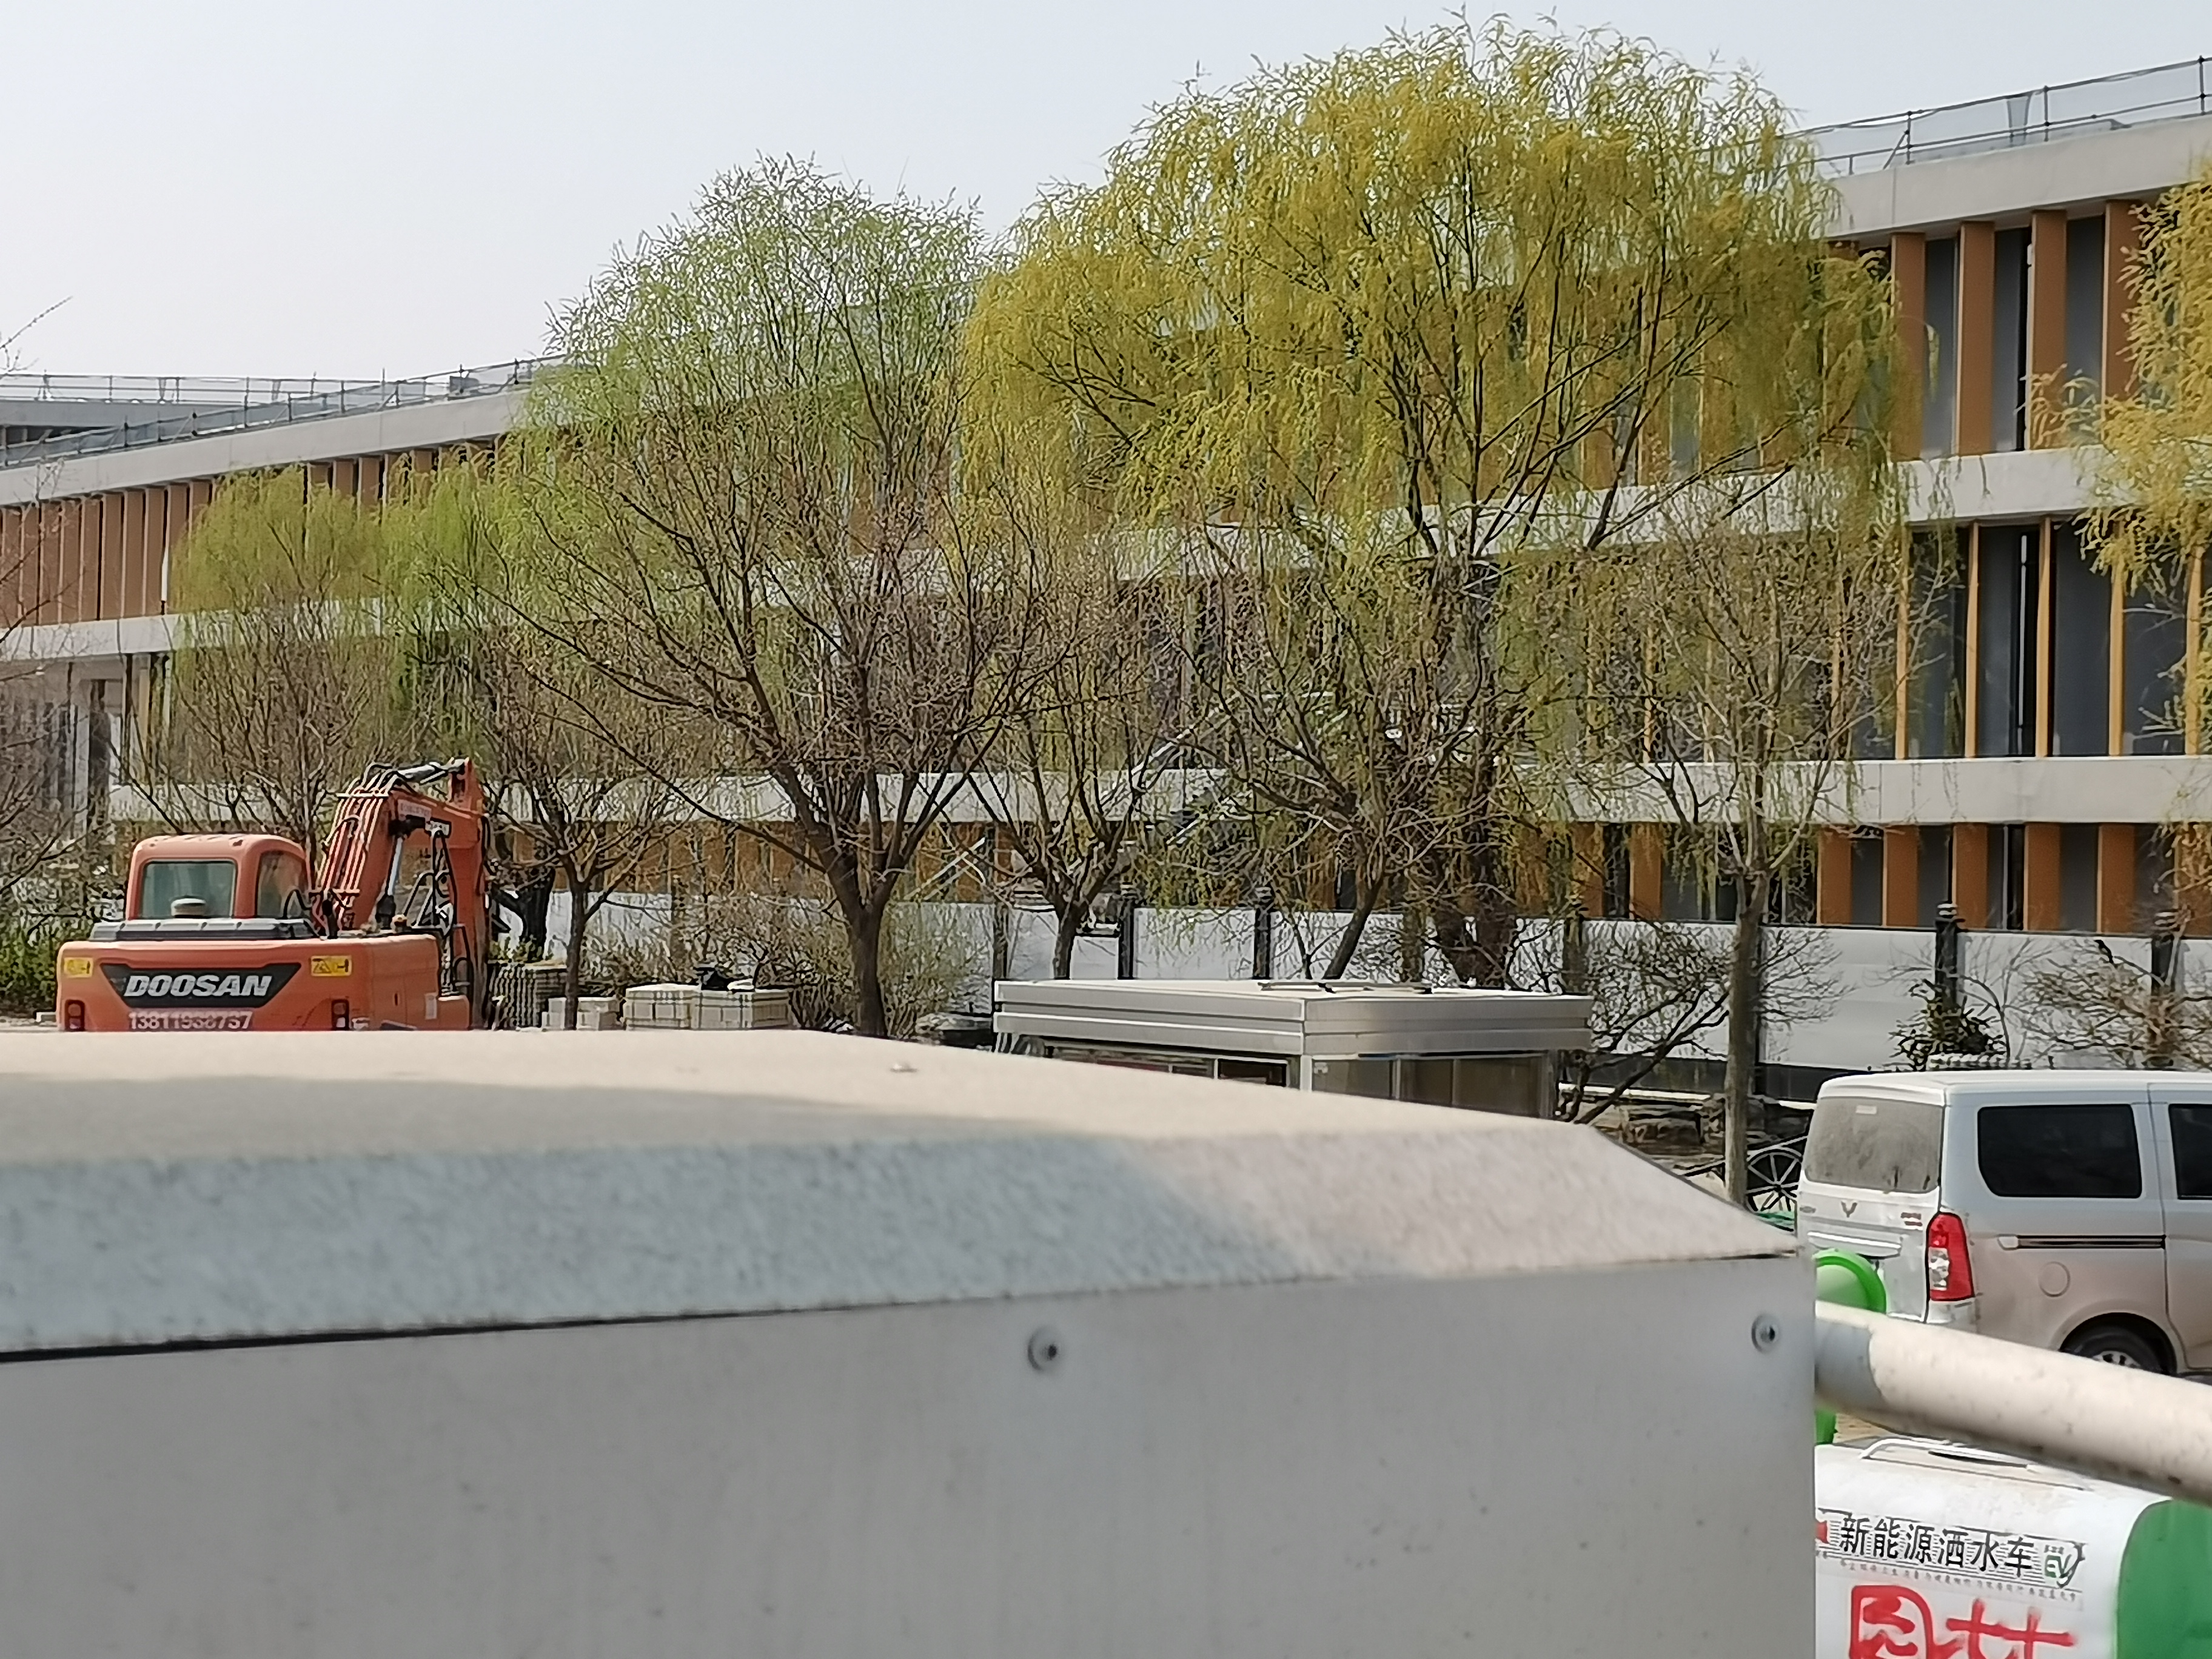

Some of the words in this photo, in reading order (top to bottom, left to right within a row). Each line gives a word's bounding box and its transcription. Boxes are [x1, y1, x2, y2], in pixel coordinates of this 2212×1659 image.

[124, 975, 272, 996] DOOSAN
[1839, 1517, 2034, 1577] 新能源洒水车
